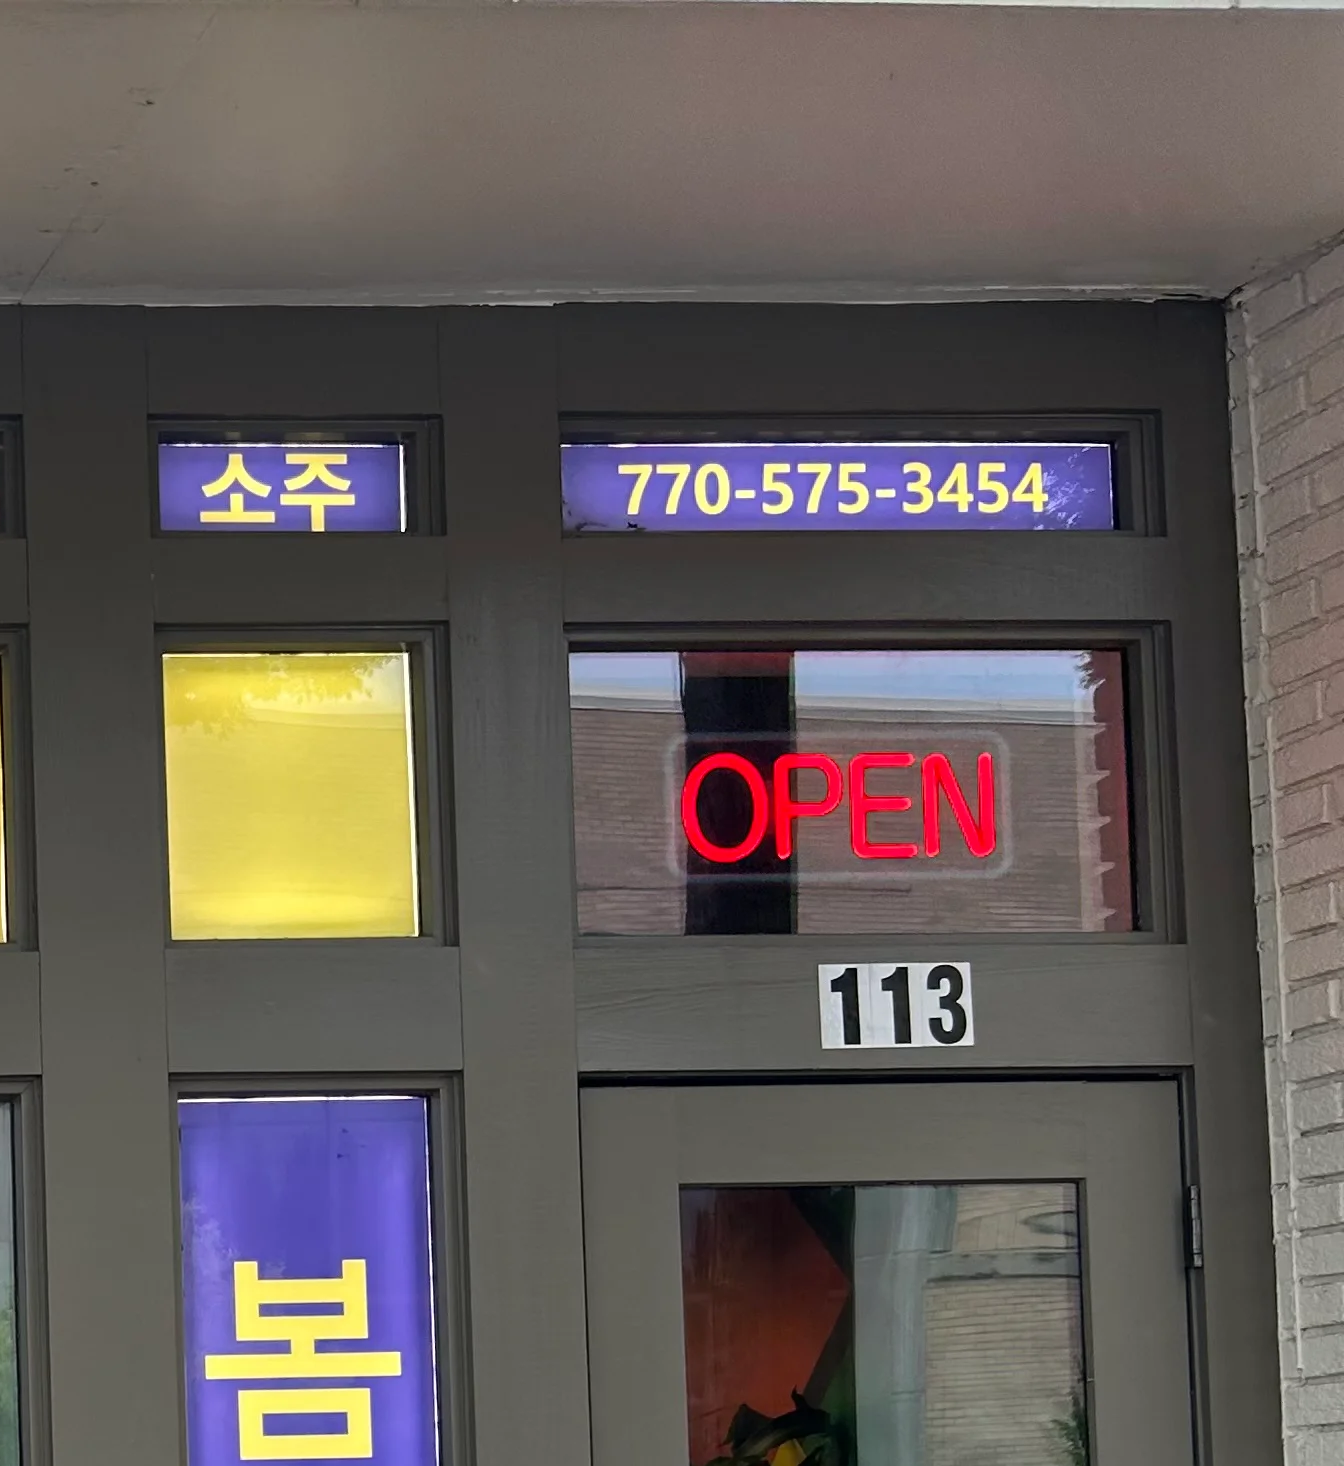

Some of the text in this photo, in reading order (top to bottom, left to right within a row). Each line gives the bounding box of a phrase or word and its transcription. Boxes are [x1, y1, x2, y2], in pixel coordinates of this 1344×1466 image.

[199, 452, 356, 532] 소주
[618, 462, 1049, 515] 770-575-3454
[681, 752, 997, 864] OPEN
[830, 965, 968, 1046] 113
